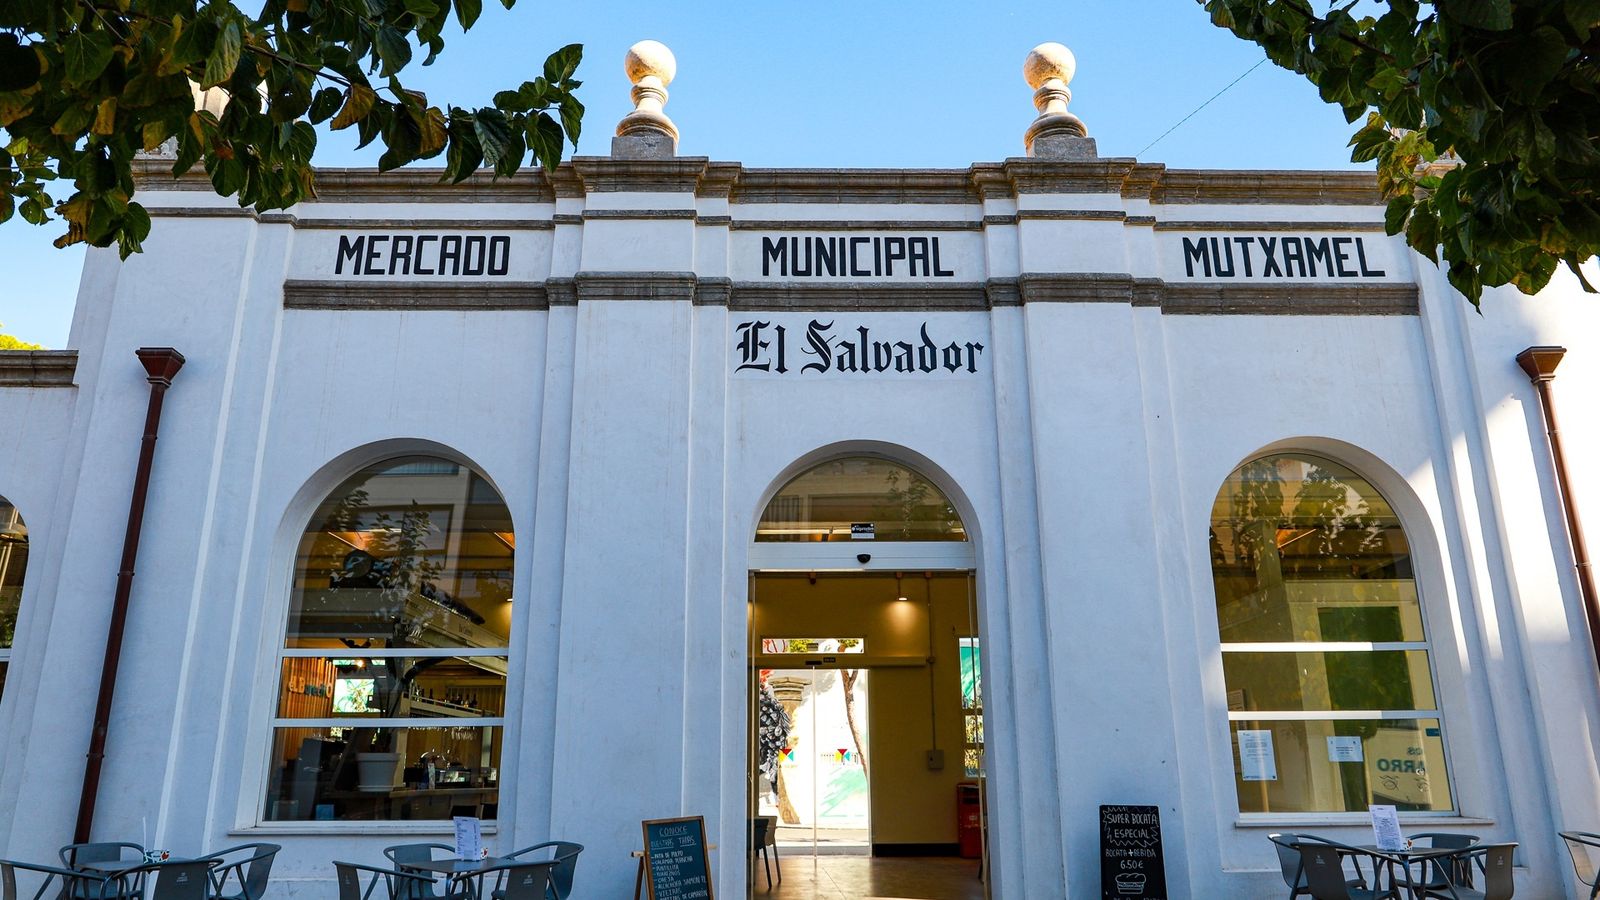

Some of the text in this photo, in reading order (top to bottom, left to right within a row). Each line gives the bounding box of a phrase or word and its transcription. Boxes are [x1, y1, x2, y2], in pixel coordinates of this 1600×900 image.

[335, 235, 1386, 277] MERCADO MUNICIPAL MUTXAMEL
[735, 318, 984, 375] El Salvador
[1106, 813, 1157, 825] SUPER BOCATA
[1114, 828, 1150, 839] ESPECIAL
